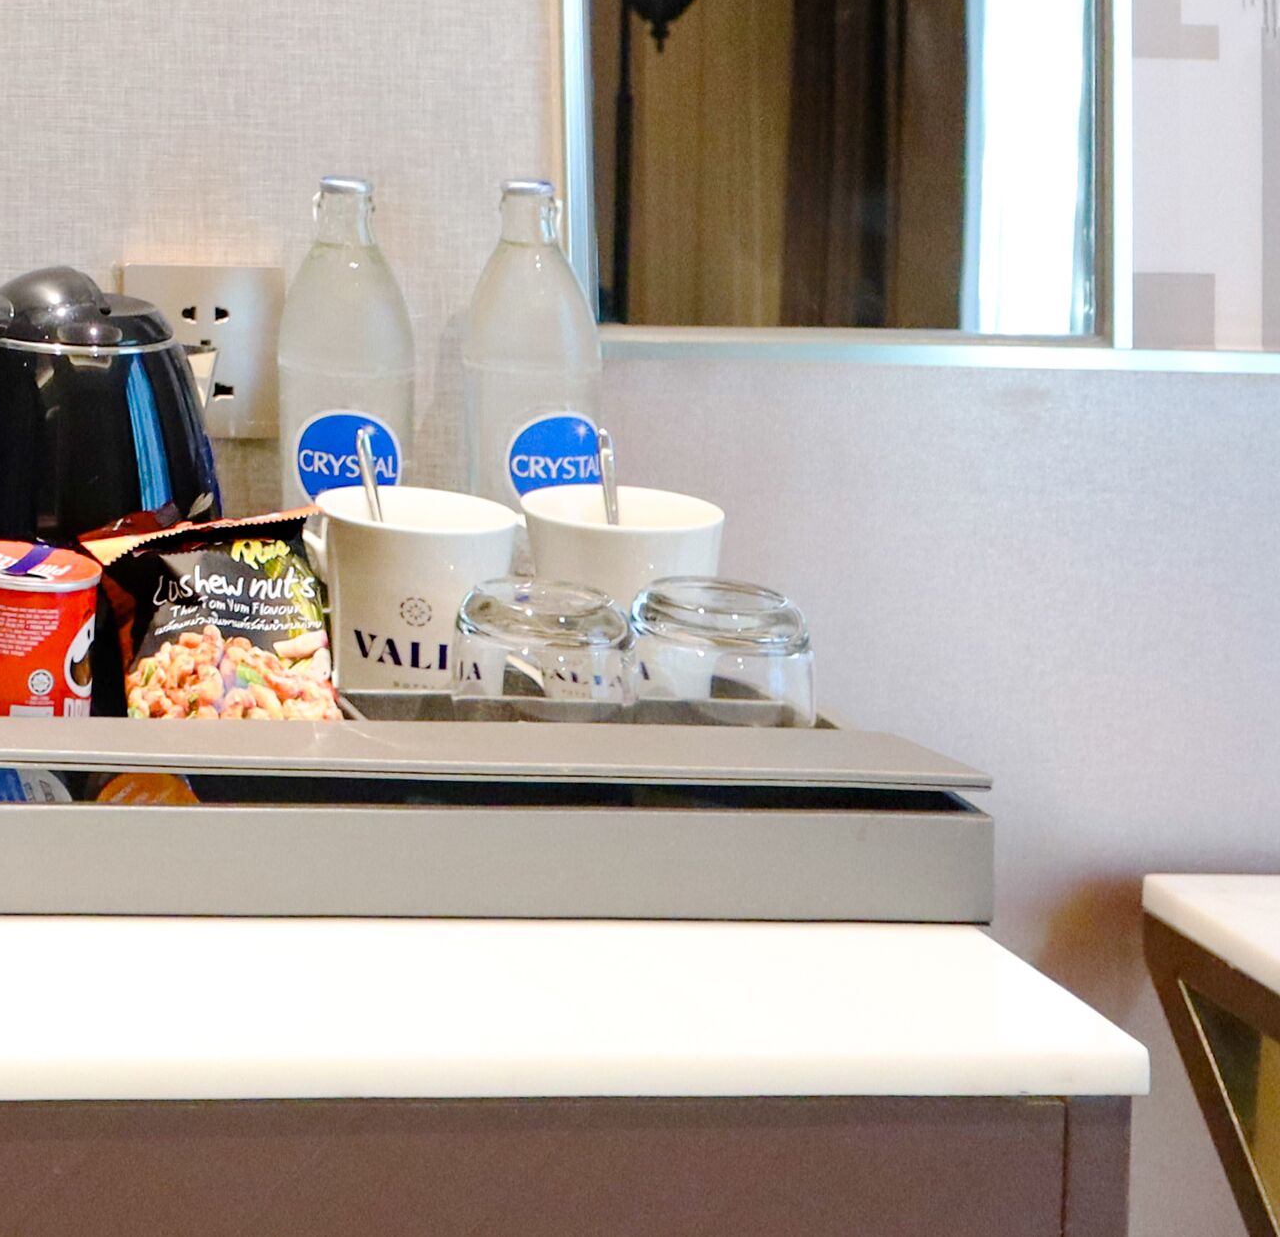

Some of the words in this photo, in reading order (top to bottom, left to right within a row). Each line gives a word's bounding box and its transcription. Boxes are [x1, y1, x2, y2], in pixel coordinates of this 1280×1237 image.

[297, 449, 397, 479] CRYSAL
[197, 595, 227, 611] Tom
[227, 600, 251, 614] Yum
[252, 601, 302, 615] Flavour
